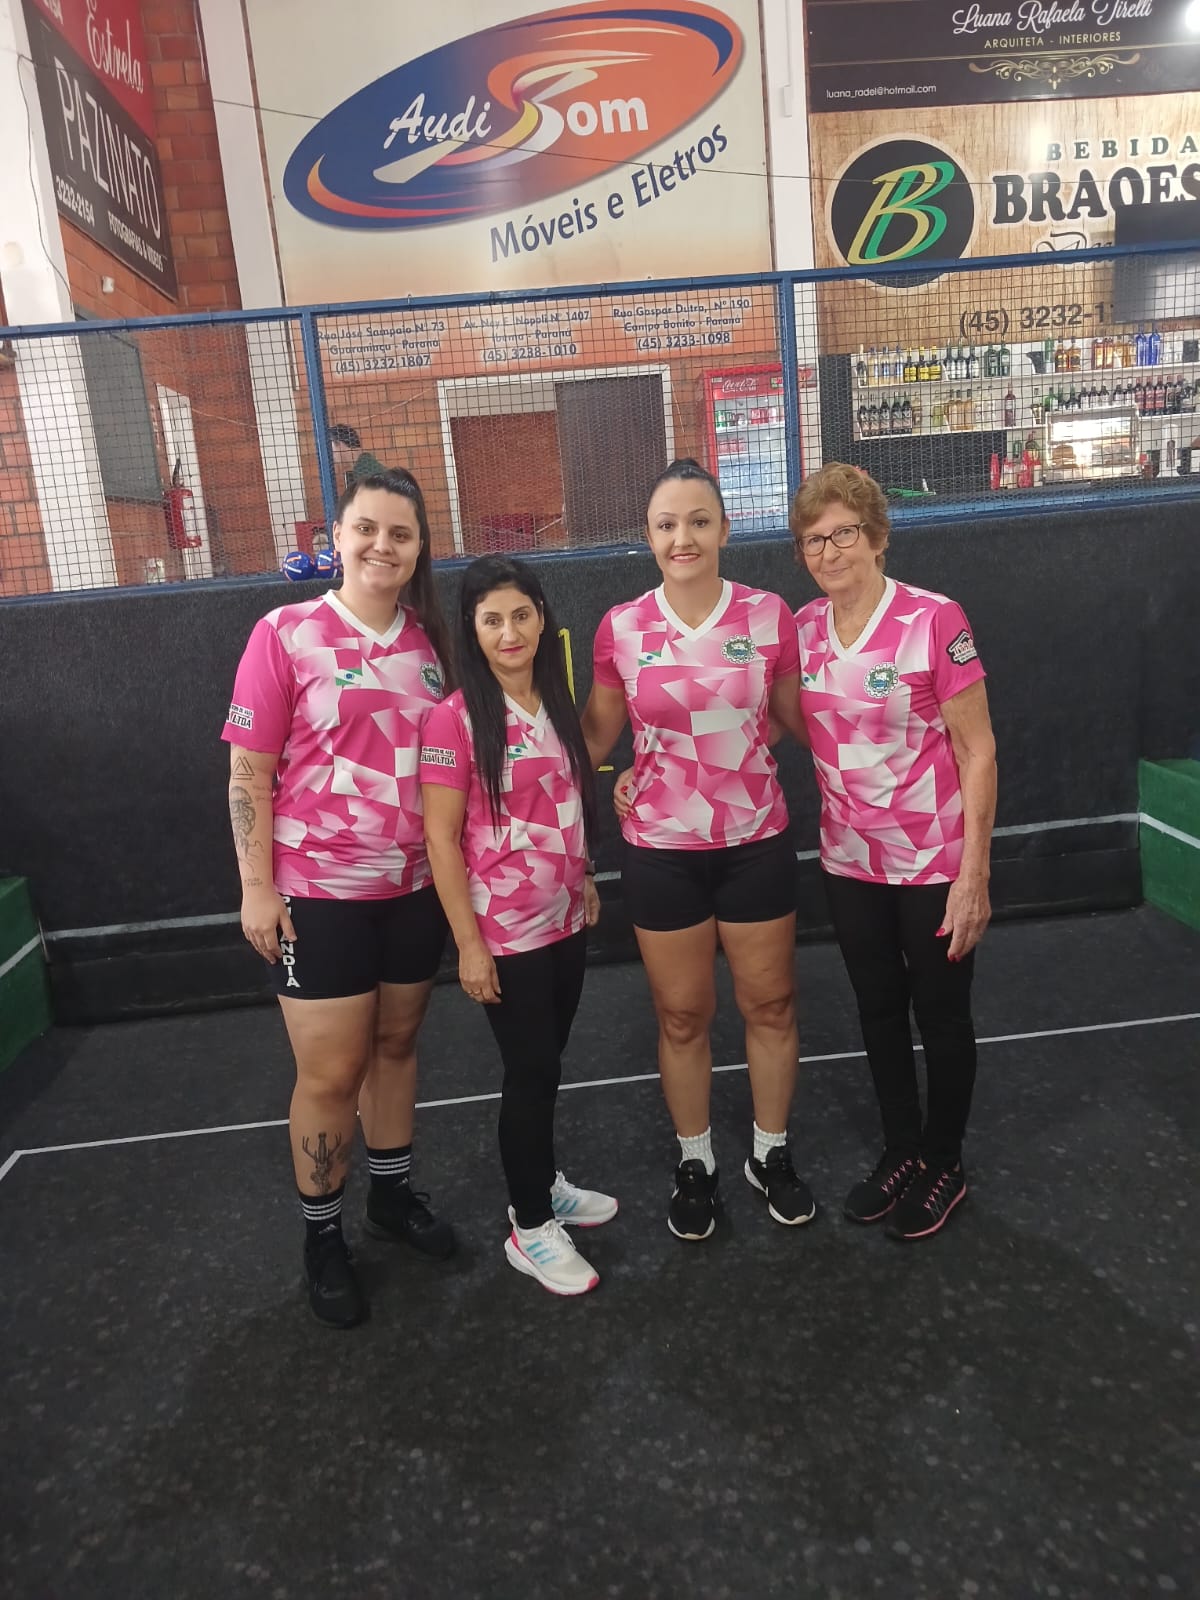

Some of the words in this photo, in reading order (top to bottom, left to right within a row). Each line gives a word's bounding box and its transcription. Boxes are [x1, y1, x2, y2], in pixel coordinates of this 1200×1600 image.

[952, 3, 1012, 34] Luana
[1016, 0, 1086, 33] Rafaela
[1091, 0, 1153, 26] Tirelli
[984, 36, 1044, 49] ARQUITETA
[1059, 31, 1121, 45] INTERIORES
[86, 11, 144, 94] Estrela
[53, 55, 161, 241] PAZINATO
[489, 199, 598, 262] Móveis
[607, 192, 625, 220] e
[630, 123, 729, 208] Eletros
[614, 308, 633, 318] Rua
[636, 306, 673, 317] Gaspar
[731, 299, 751, 309] 190
[515, 314, 547, 327] Napoli
[567, 311, 590, 321] 1407
[624, 322, 661, 333] Campo
[663, 318, 696, 330] Bonito
[705, 315, 741, 326] Paraná
[960, 307, 1009, 338] (45)
[1019, 301, 1114, 330] 3232-1
[366, 326, 412, 337] Sampaio
[431, 321, 445, 332] 73
[637, 337, 662, 350] (45)
[483, 349, 508, 362] (45)
[335, 361, 361, 374] (45)
[231, 714, 252, 729] LTDA
[437, 754, 456, 767] LTDA
